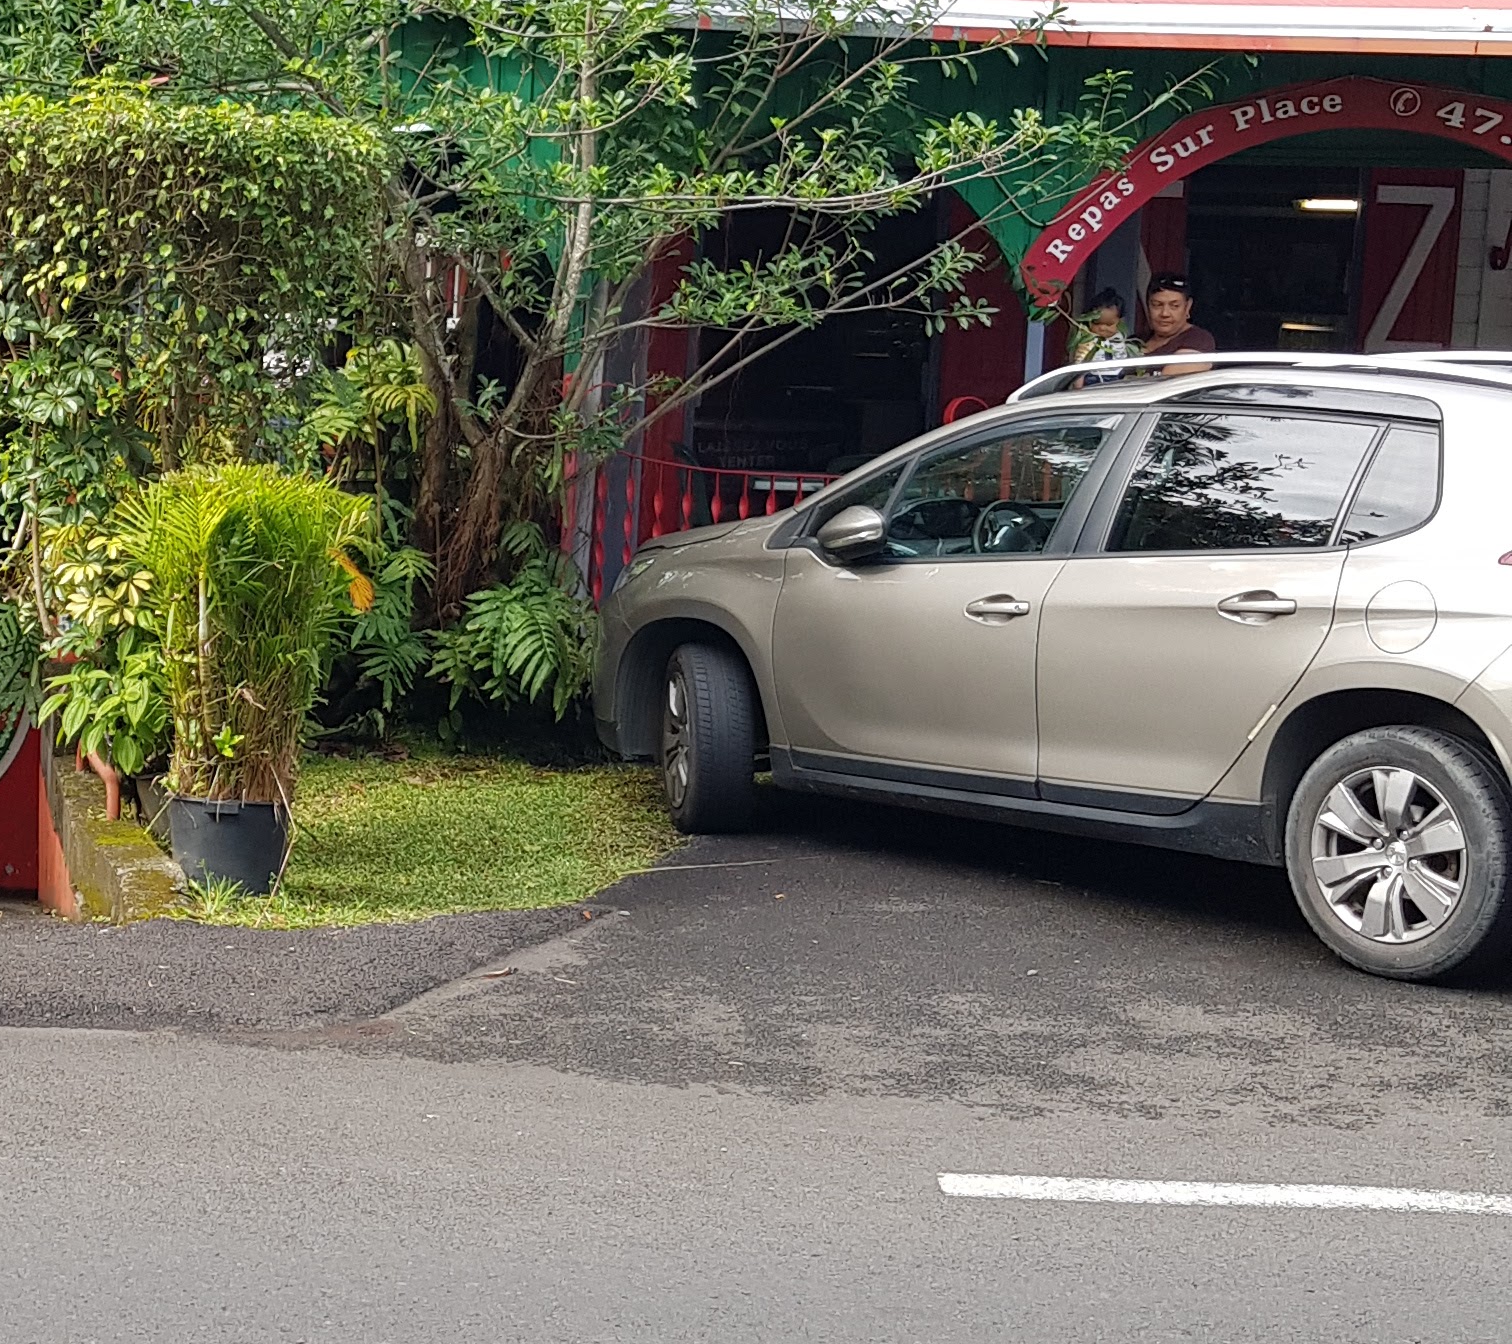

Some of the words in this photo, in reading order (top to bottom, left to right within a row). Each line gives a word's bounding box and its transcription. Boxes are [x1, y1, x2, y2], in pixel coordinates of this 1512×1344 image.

[1045, 177, 1136, 264] Repas
[1149, 124, 1215, 173] Sur
[1229, 94, 1343, 133] Place
